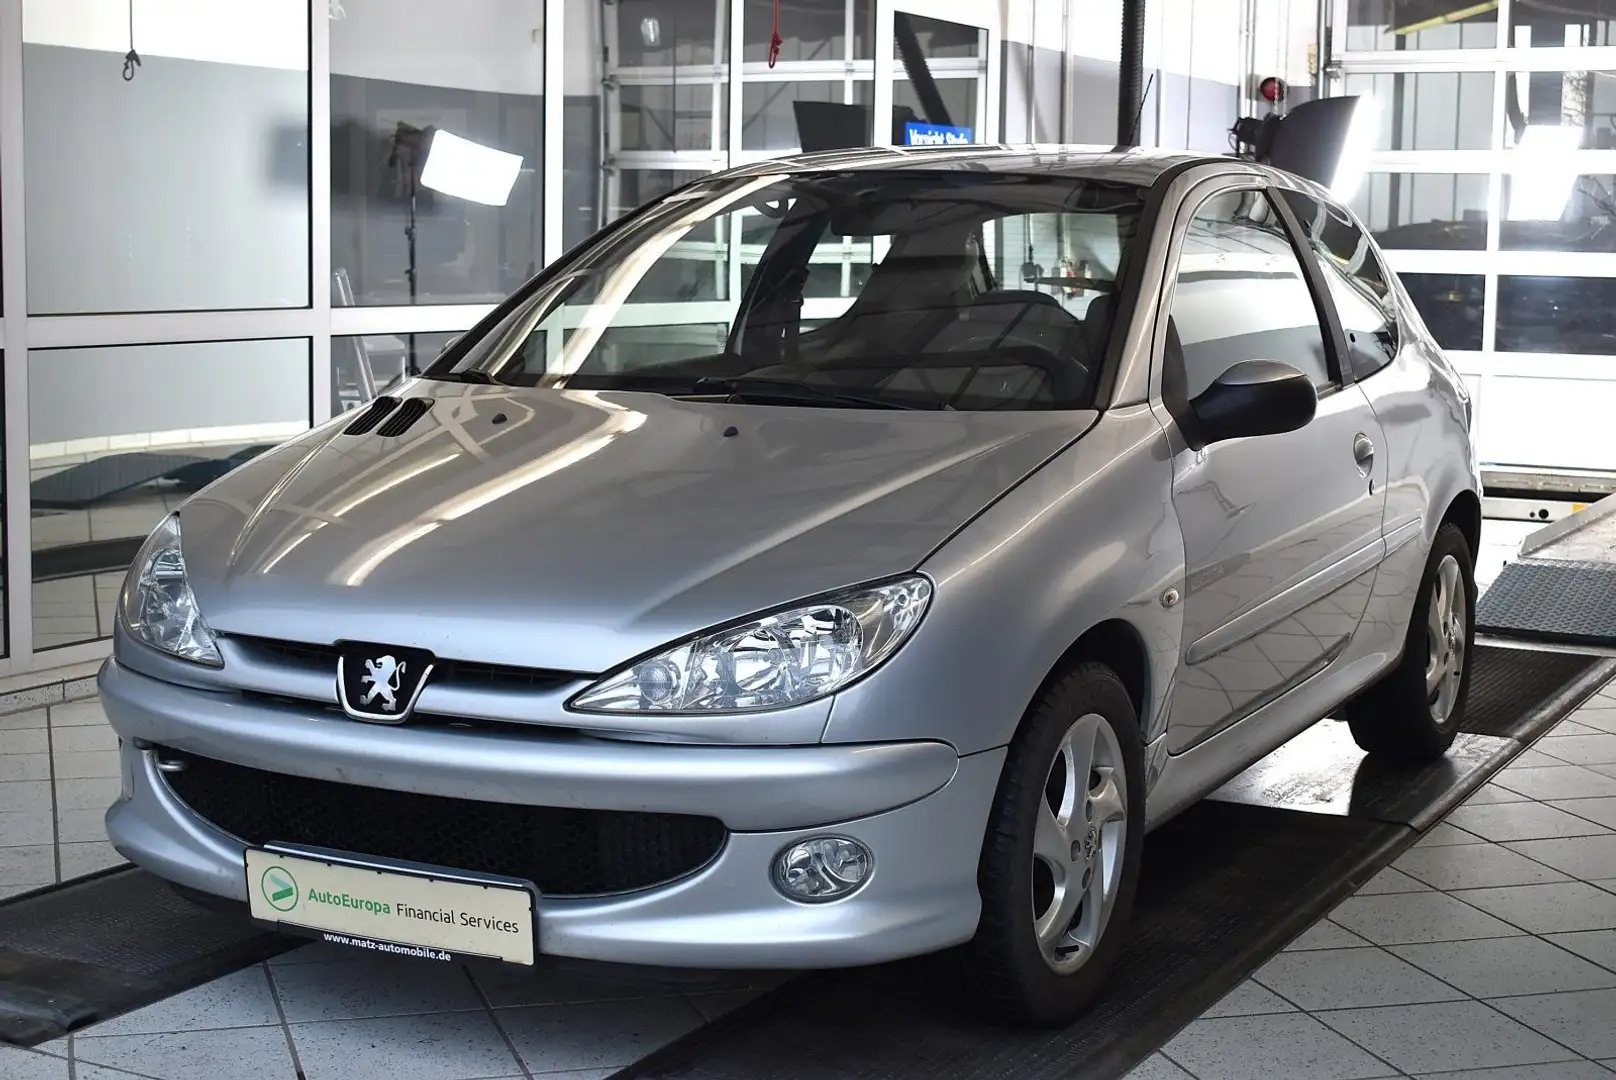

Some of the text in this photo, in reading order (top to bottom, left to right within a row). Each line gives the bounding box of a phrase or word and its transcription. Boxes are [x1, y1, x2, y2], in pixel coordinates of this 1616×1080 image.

[308, 888, 519, 933] AutoEuropa Financial Services
[323, 933, 452, 961] www.matz-automobile.de
